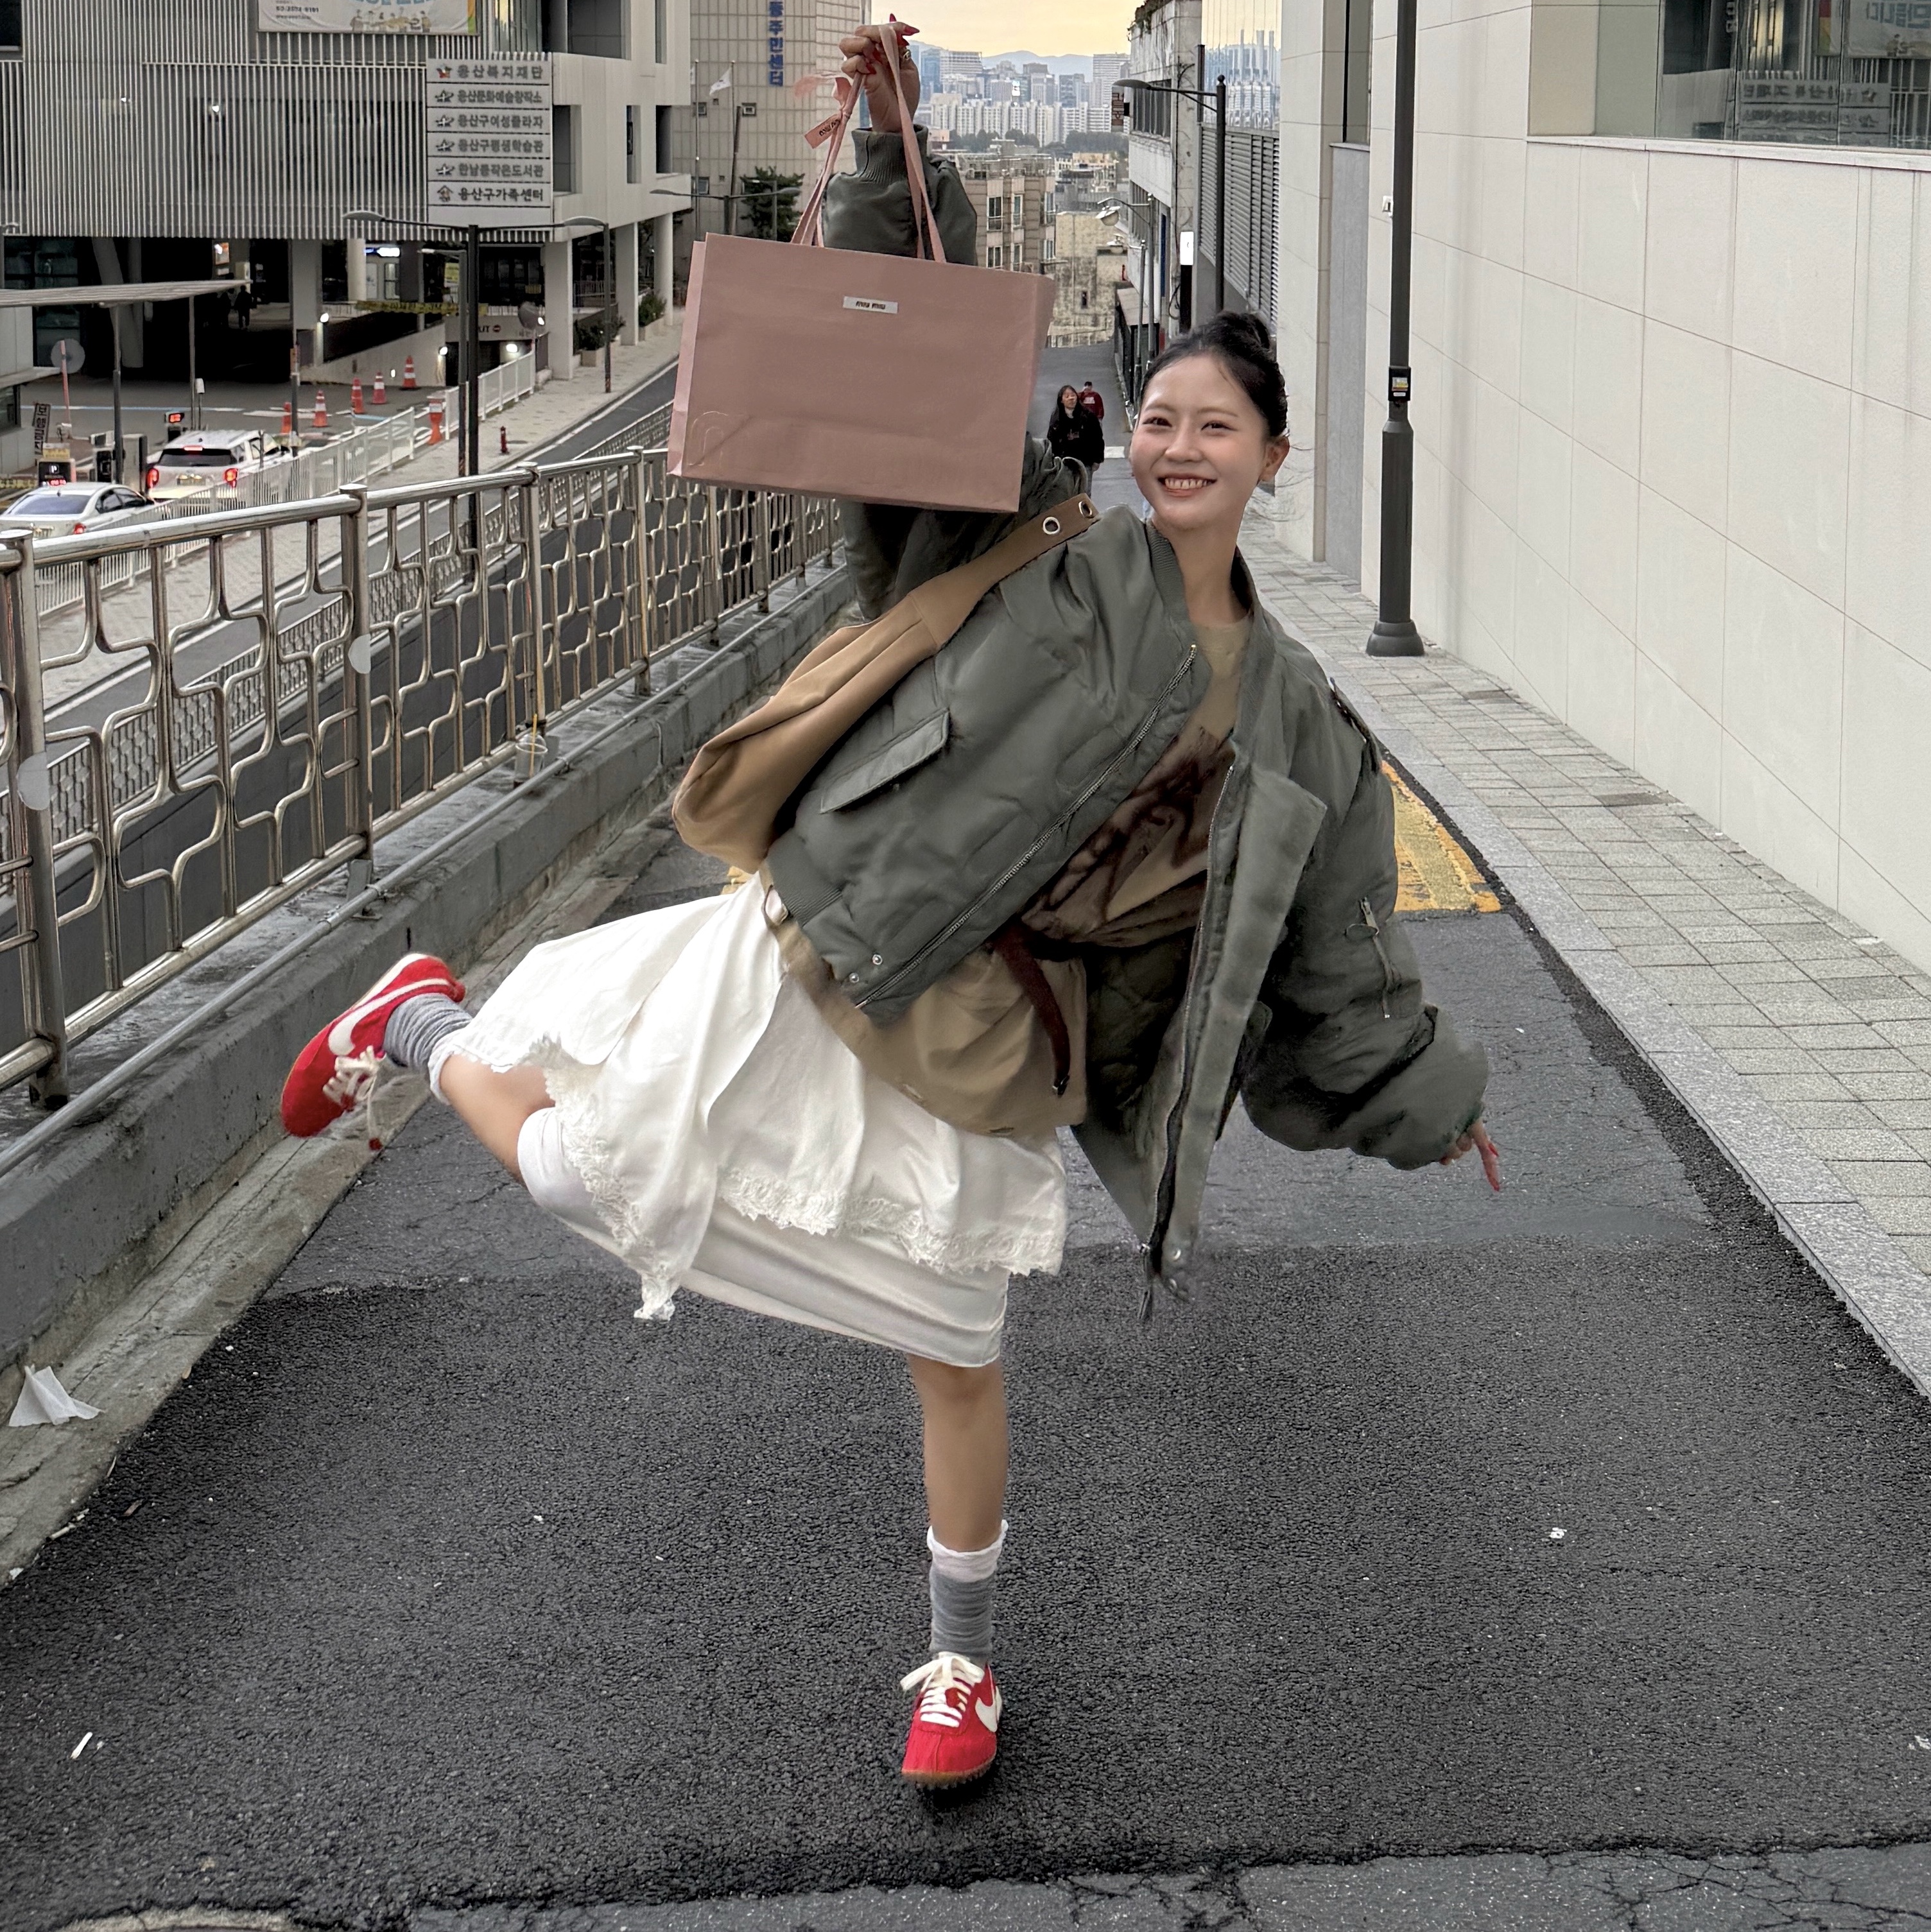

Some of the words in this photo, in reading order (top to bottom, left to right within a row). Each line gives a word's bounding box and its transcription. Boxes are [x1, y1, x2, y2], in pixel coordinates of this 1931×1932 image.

[458, 114, 543, 128] 용산구여성플라자
[458, 139, 543, 153] 용산구평생학습관
[458, 163, 543, 178] 한남동작은도서관
[458, 187, 543, 202] 용산구가족센터
